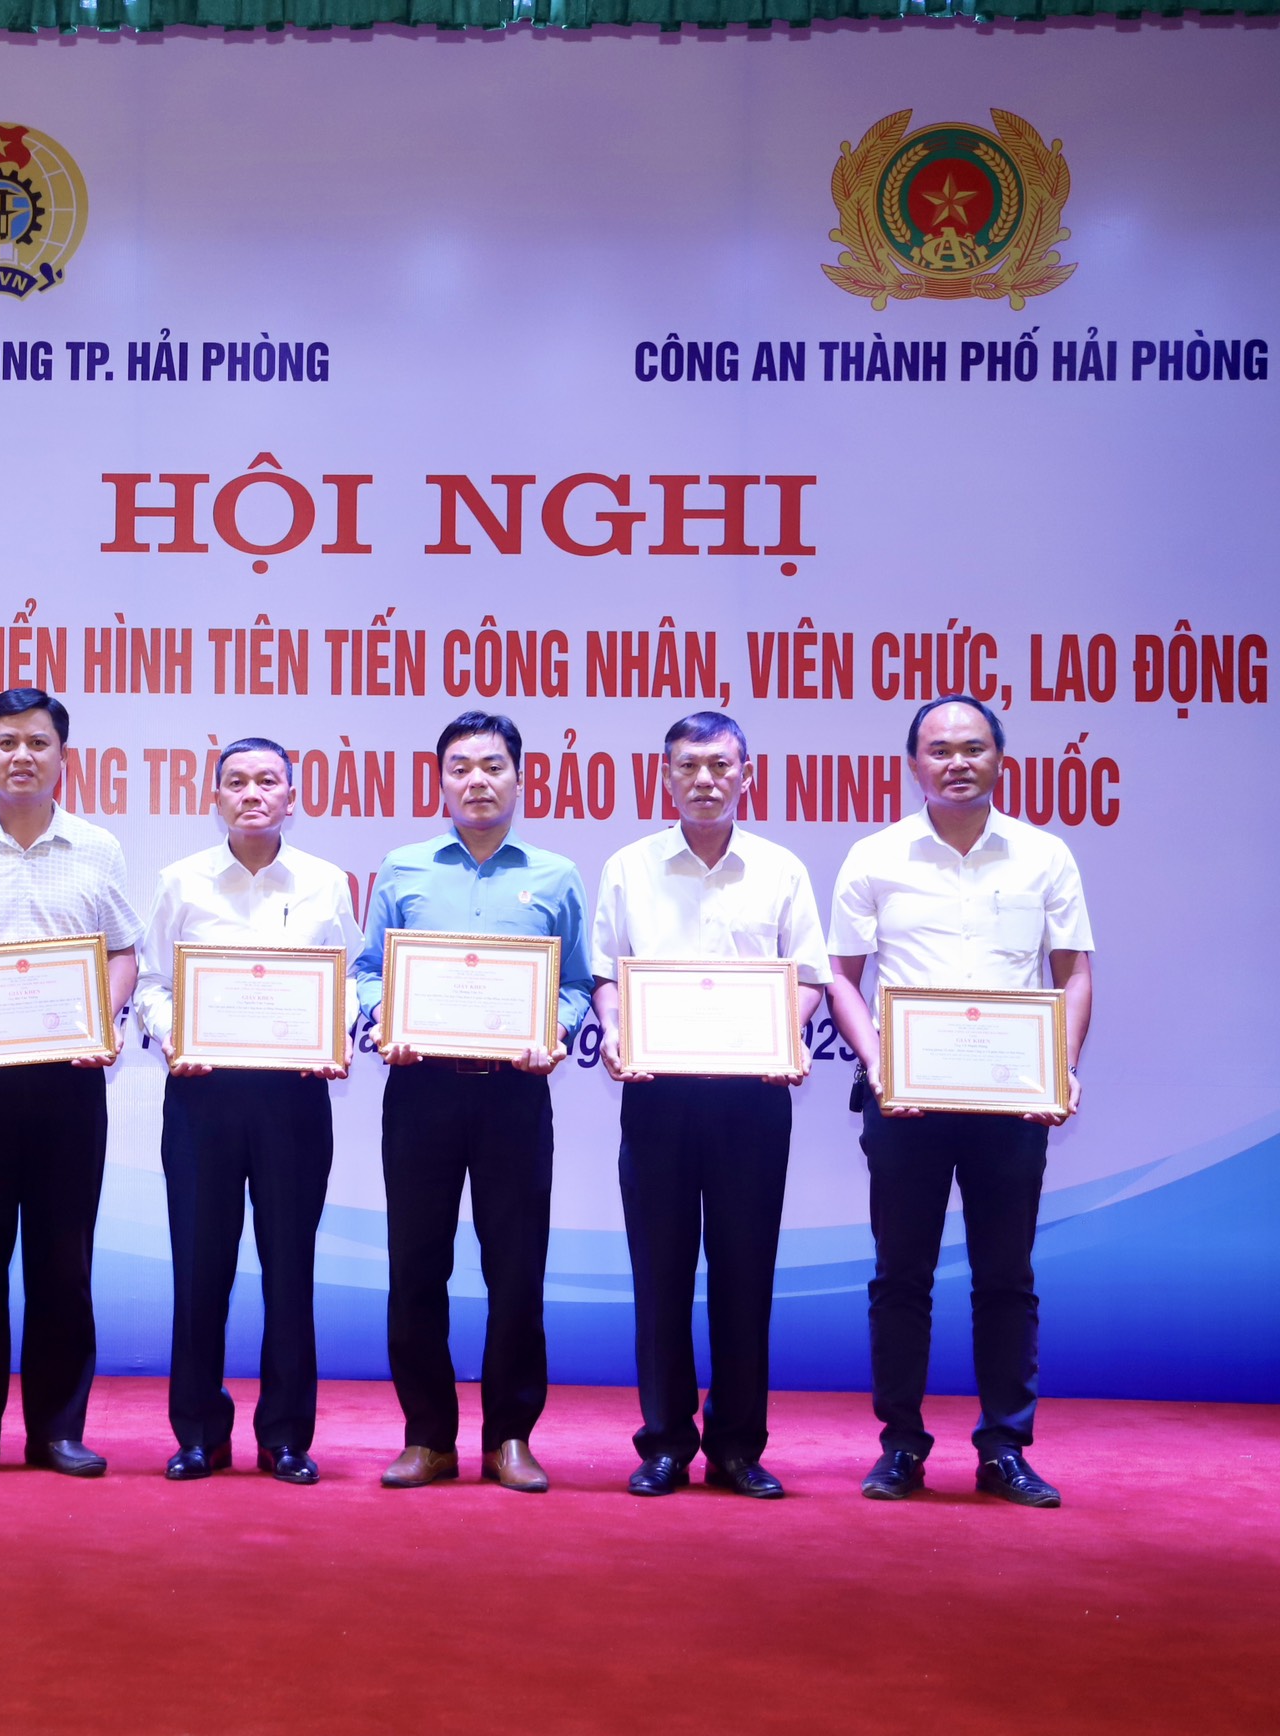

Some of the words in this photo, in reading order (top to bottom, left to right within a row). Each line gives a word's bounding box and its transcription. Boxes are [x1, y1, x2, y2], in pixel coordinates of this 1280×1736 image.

[65, 341, 114, 382] TP.
[127, 328, 189, 382] HẢI
[202, 331, 329, 383] PHÒNG
[634, 332, 739, 382] CÔNG
[751, 341, 806, 382] AN
[818, 332, 947, 382] THÀNH
[960, 326, 1041, 382] PHỐ
[1052, 326, 1118, 382] HẢI
[1131, 329, 1269, 382] PHÒNG
[99, 451, 374, 575] HỘI
[424, 472, 818, 577] NGHỊ
[84, 612, 193, 695] HÌNH
[208, 613, 309, 695] TIÊN
[325, 606, 427, 697] TIẾN
[443, 614, 569, 698] CÔNG
[585, 615, 731, 707] NHÂN,
[747, 616, 854, 701] VIÊN
[872, 617, 1013, 711] CHỨC,
[1030, 634, 1117, 703] LAO
[1133, 618, 1268, 720] ĐỘNG
[523, 728, 615, 821] BẢO
[785, 753, 901, 824] NINH
